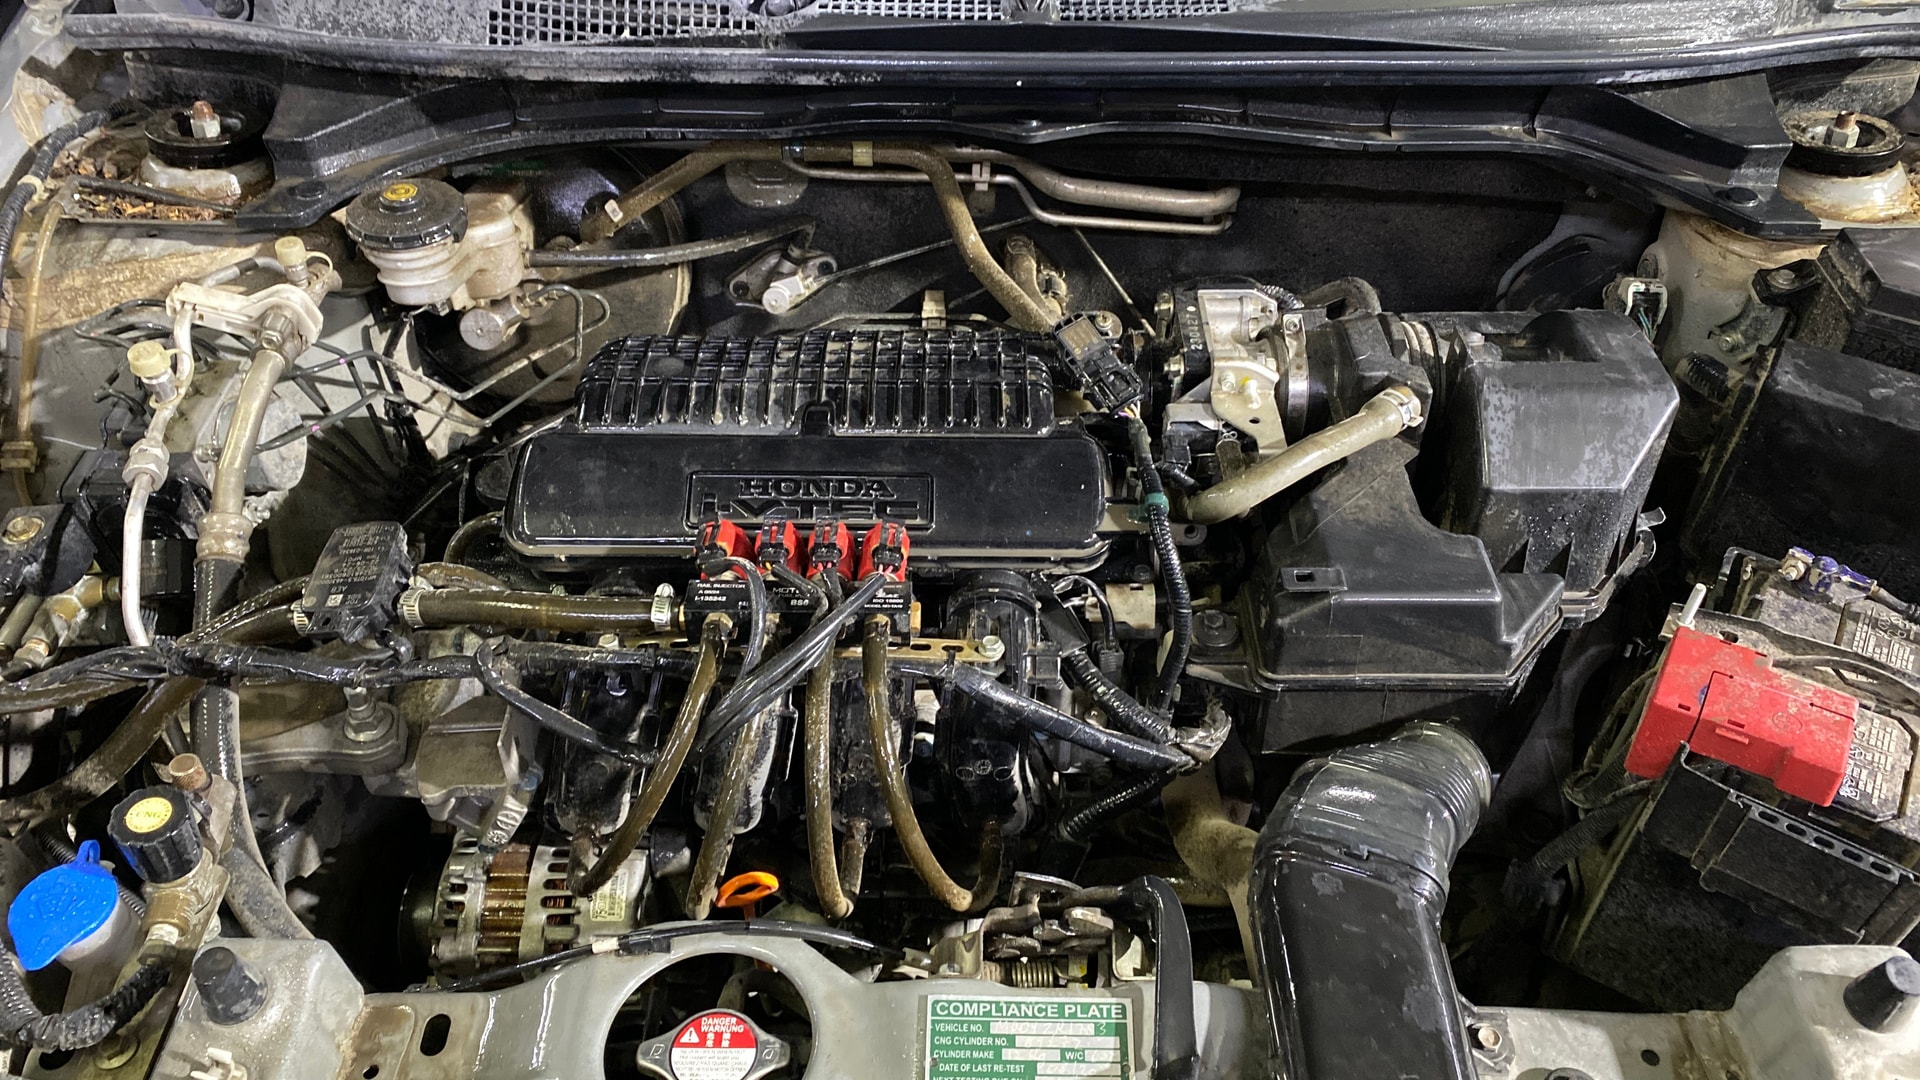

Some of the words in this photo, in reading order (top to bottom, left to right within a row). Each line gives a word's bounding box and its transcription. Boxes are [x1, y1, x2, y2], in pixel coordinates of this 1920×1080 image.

[1186, 314, 1202, 350] 230427
[738, 478, 896, 500] HONDA
[936, 1002, 1059, 1018] COMPLIANCE
[1064, 1004, 1123, 1018] PLATE
[935, 1023, 969, 1032] VEHICLE
[970, 1023, 984, 1033] NO.
[934, 1036, 951, 1045] CNG
[953, 1036, 993, 1046] CYLINDER
[995, 1037, 1009, 1046] NO.
[933, 1049, 968, 1059] CYLINDER
[970, 1050, 994, 1059] MAKE
[1065, 1051, 1084, 1060] W/C
[939, 1063, 958, 1072] DATE
[961, 1064, 973, 1072] OF
[974, 1064, 992, 1073] LAST
[994, 1064, 1025, 1073] RE-TEST
